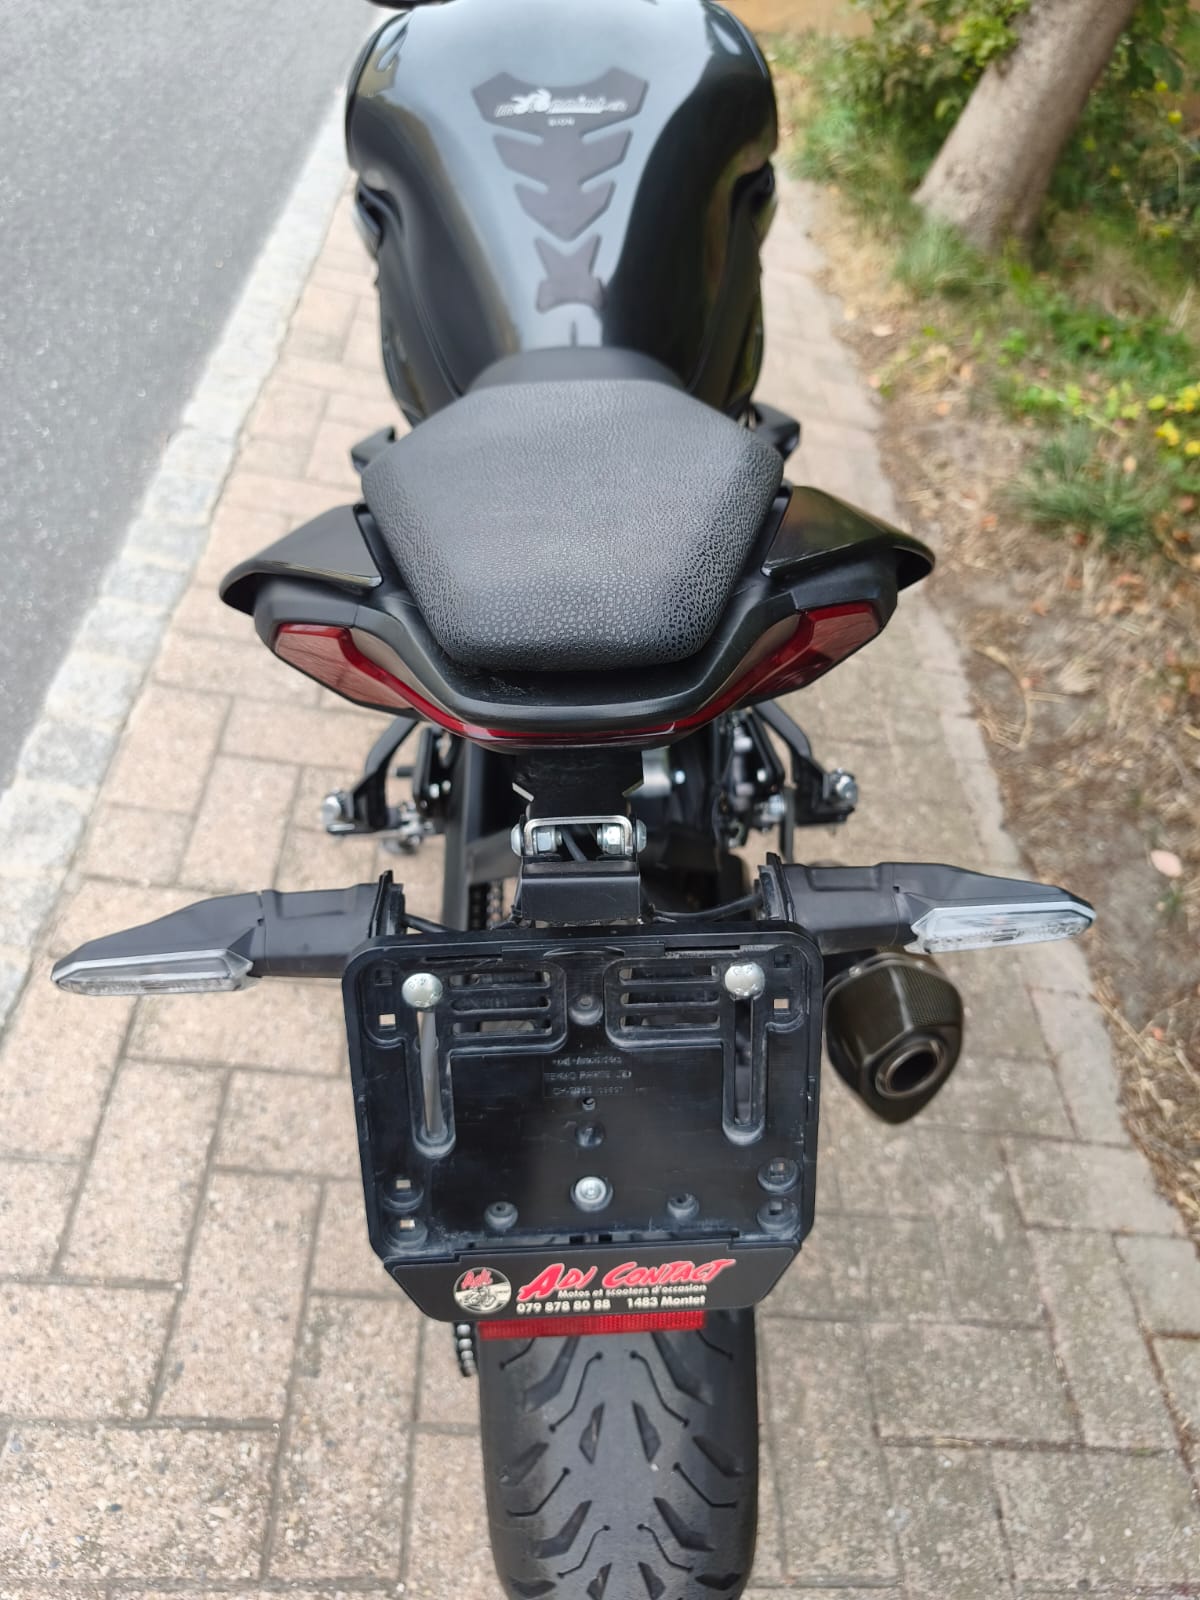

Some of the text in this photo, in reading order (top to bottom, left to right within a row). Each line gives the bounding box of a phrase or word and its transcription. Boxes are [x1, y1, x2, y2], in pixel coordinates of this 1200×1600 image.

[602, 1258, 736, 1288] CONTACT
[558, 1284, 707, 1299] Motos et scooters d'occasion
[516, 1298, 611, 1314] 079 878 80 88
[627, 1295, 705, 1310] 1483 Montet
